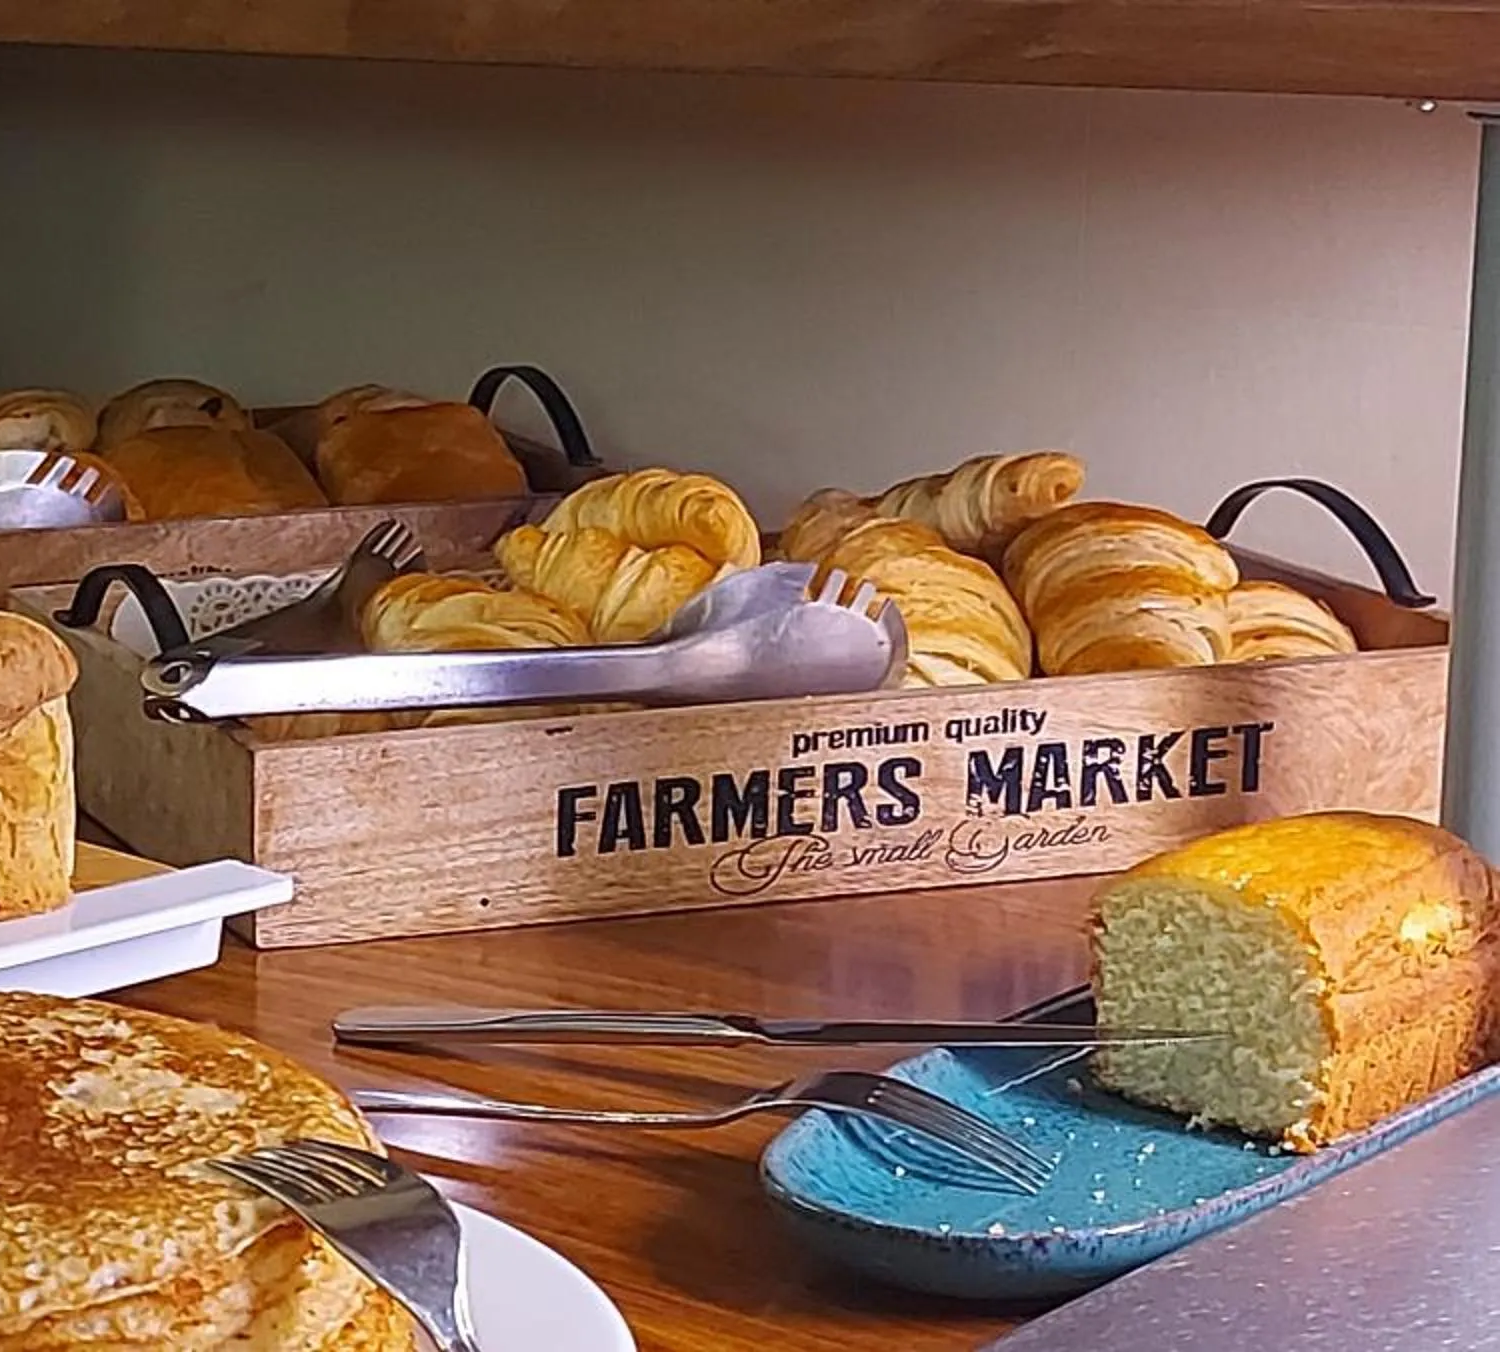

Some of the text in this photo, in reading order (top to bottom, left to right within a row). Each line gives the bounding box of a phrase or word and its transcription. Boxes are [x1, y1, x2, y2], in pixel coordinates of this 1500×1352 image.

[792, 707, 1047, 758] premium quality
[557, 721, 1275, 858] FARMERS MARKET
[710, 815, 1114, 896] The small Garden
